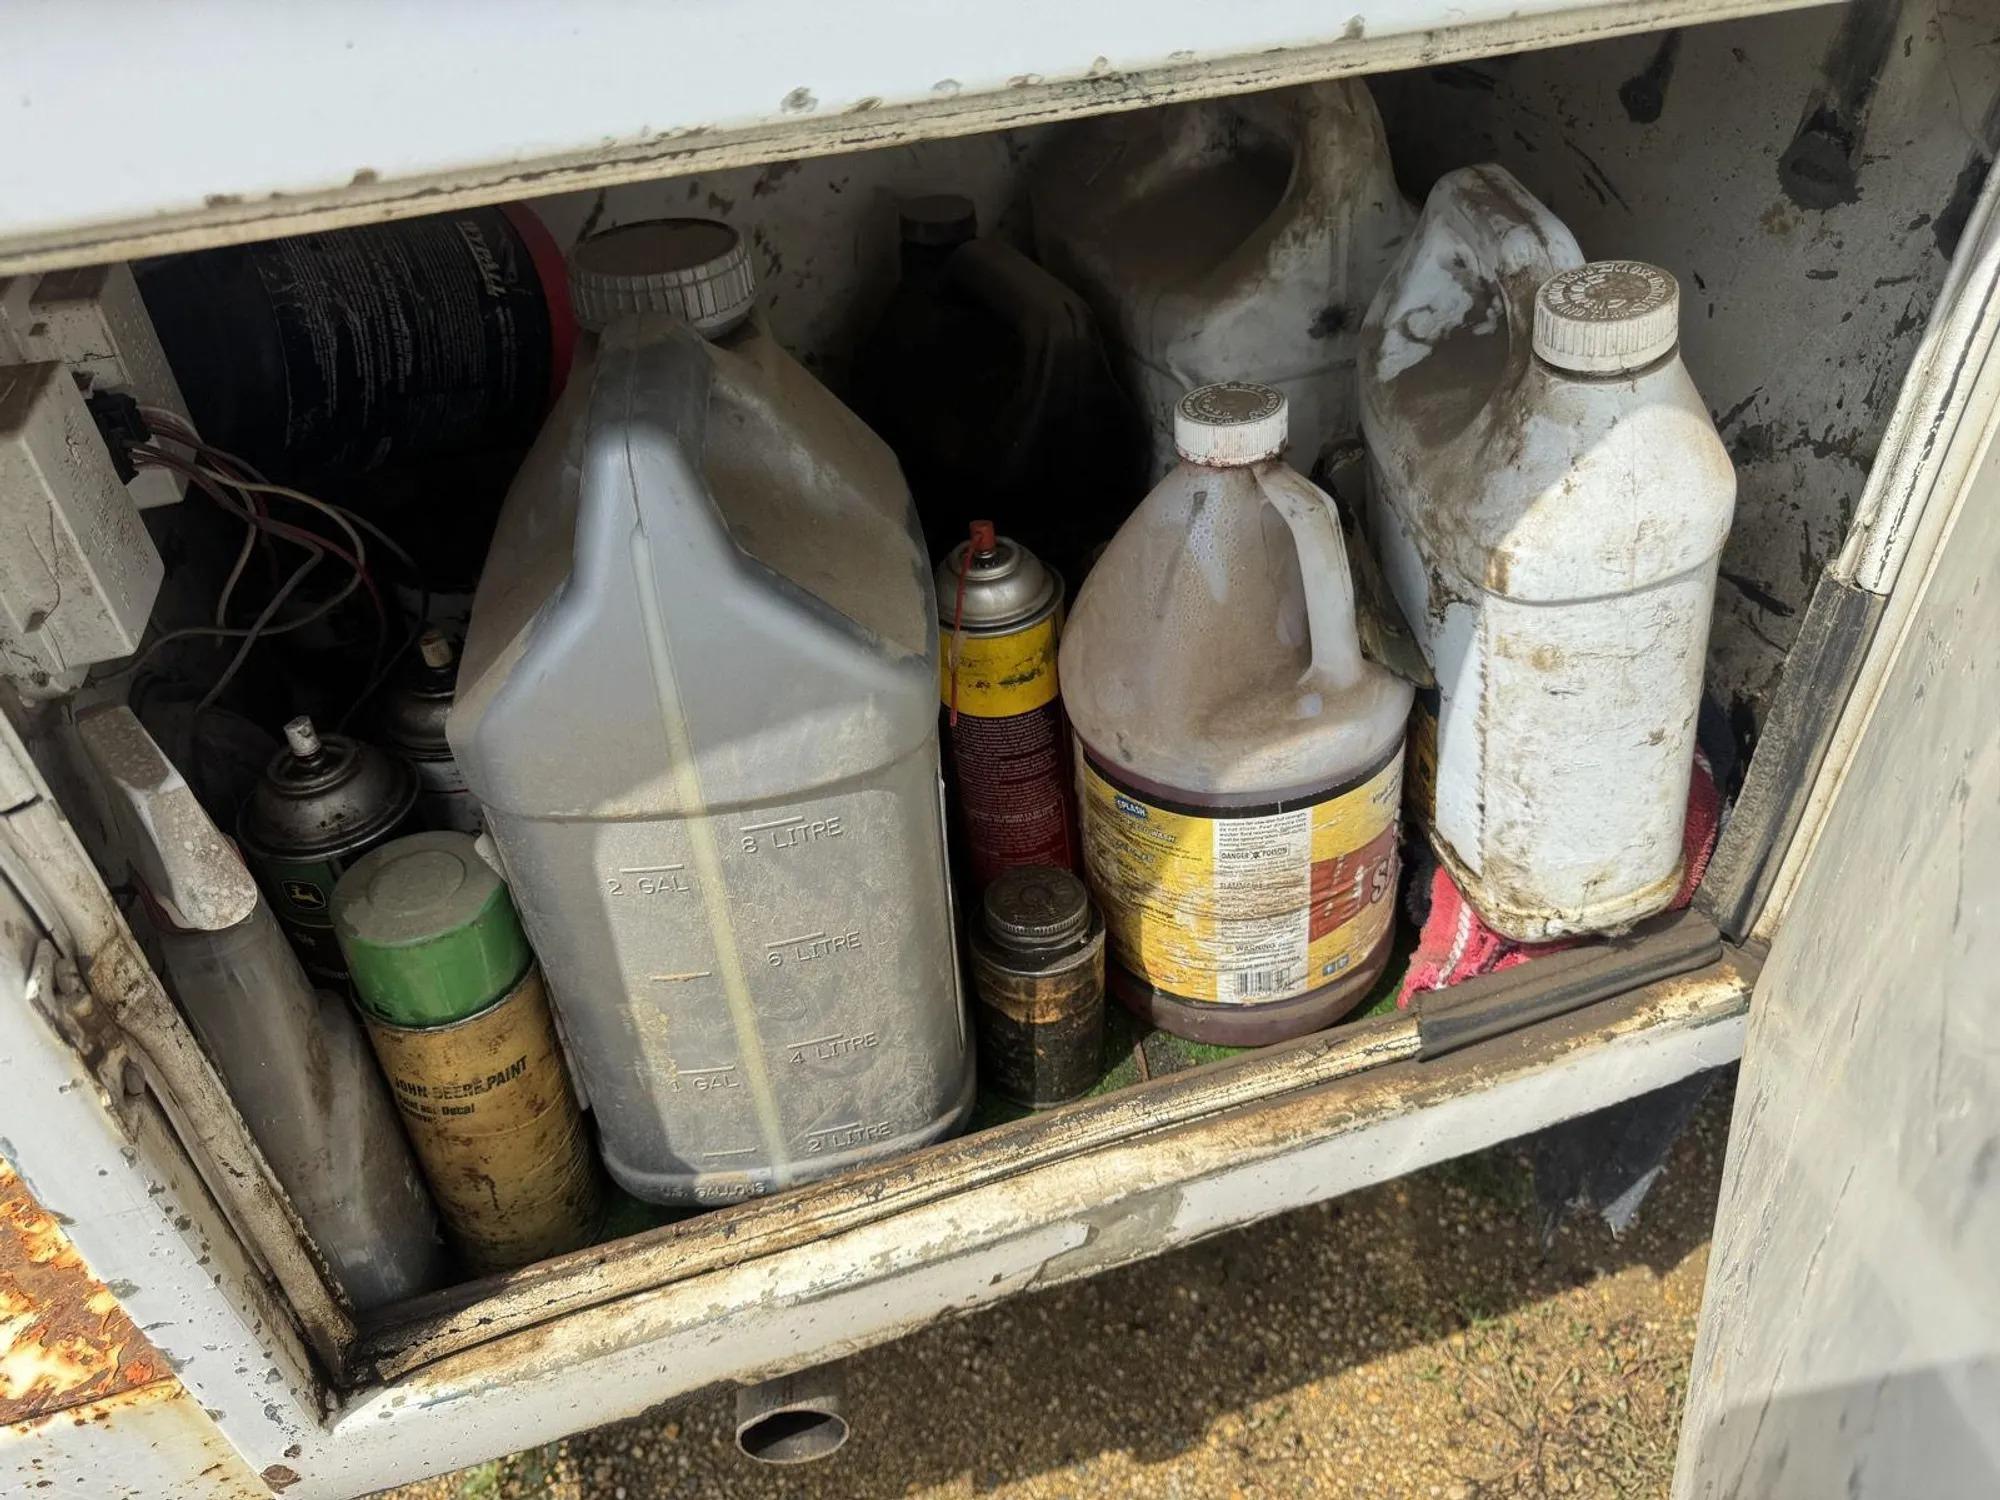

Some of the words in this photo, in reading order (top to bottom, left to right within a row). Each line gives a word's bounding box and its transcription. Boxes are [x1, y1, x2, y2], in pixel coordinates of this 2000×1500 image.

[741, 835, 758, 853] 8
[771, 816, 843, 849] LITRE
[1221, 852, 1249, 860] DANGER
[1262, 847, 1288, 858] POISON
[607, 877, 624, 896] 2
[638, 875, 690, 895] GAL
[767, 951, 783, 967] 6
[795, 931, 862, 962] LITRE
[789, 1050, 805, 1064] 4
[816, 1032, 880, 1060] LITRE
[394, 1075, 429, 1099] JOHN
[485, 1054, 527, 1091] PAINT
[692, 1075, 740, 1092] GAL
[441, 1103, 476, 1116] Decal
[807, 1138, 822, 1153] 2
[833, 1121, 893, 1147] LITRE
[694, 1182, 768, 1198] GALLONS
